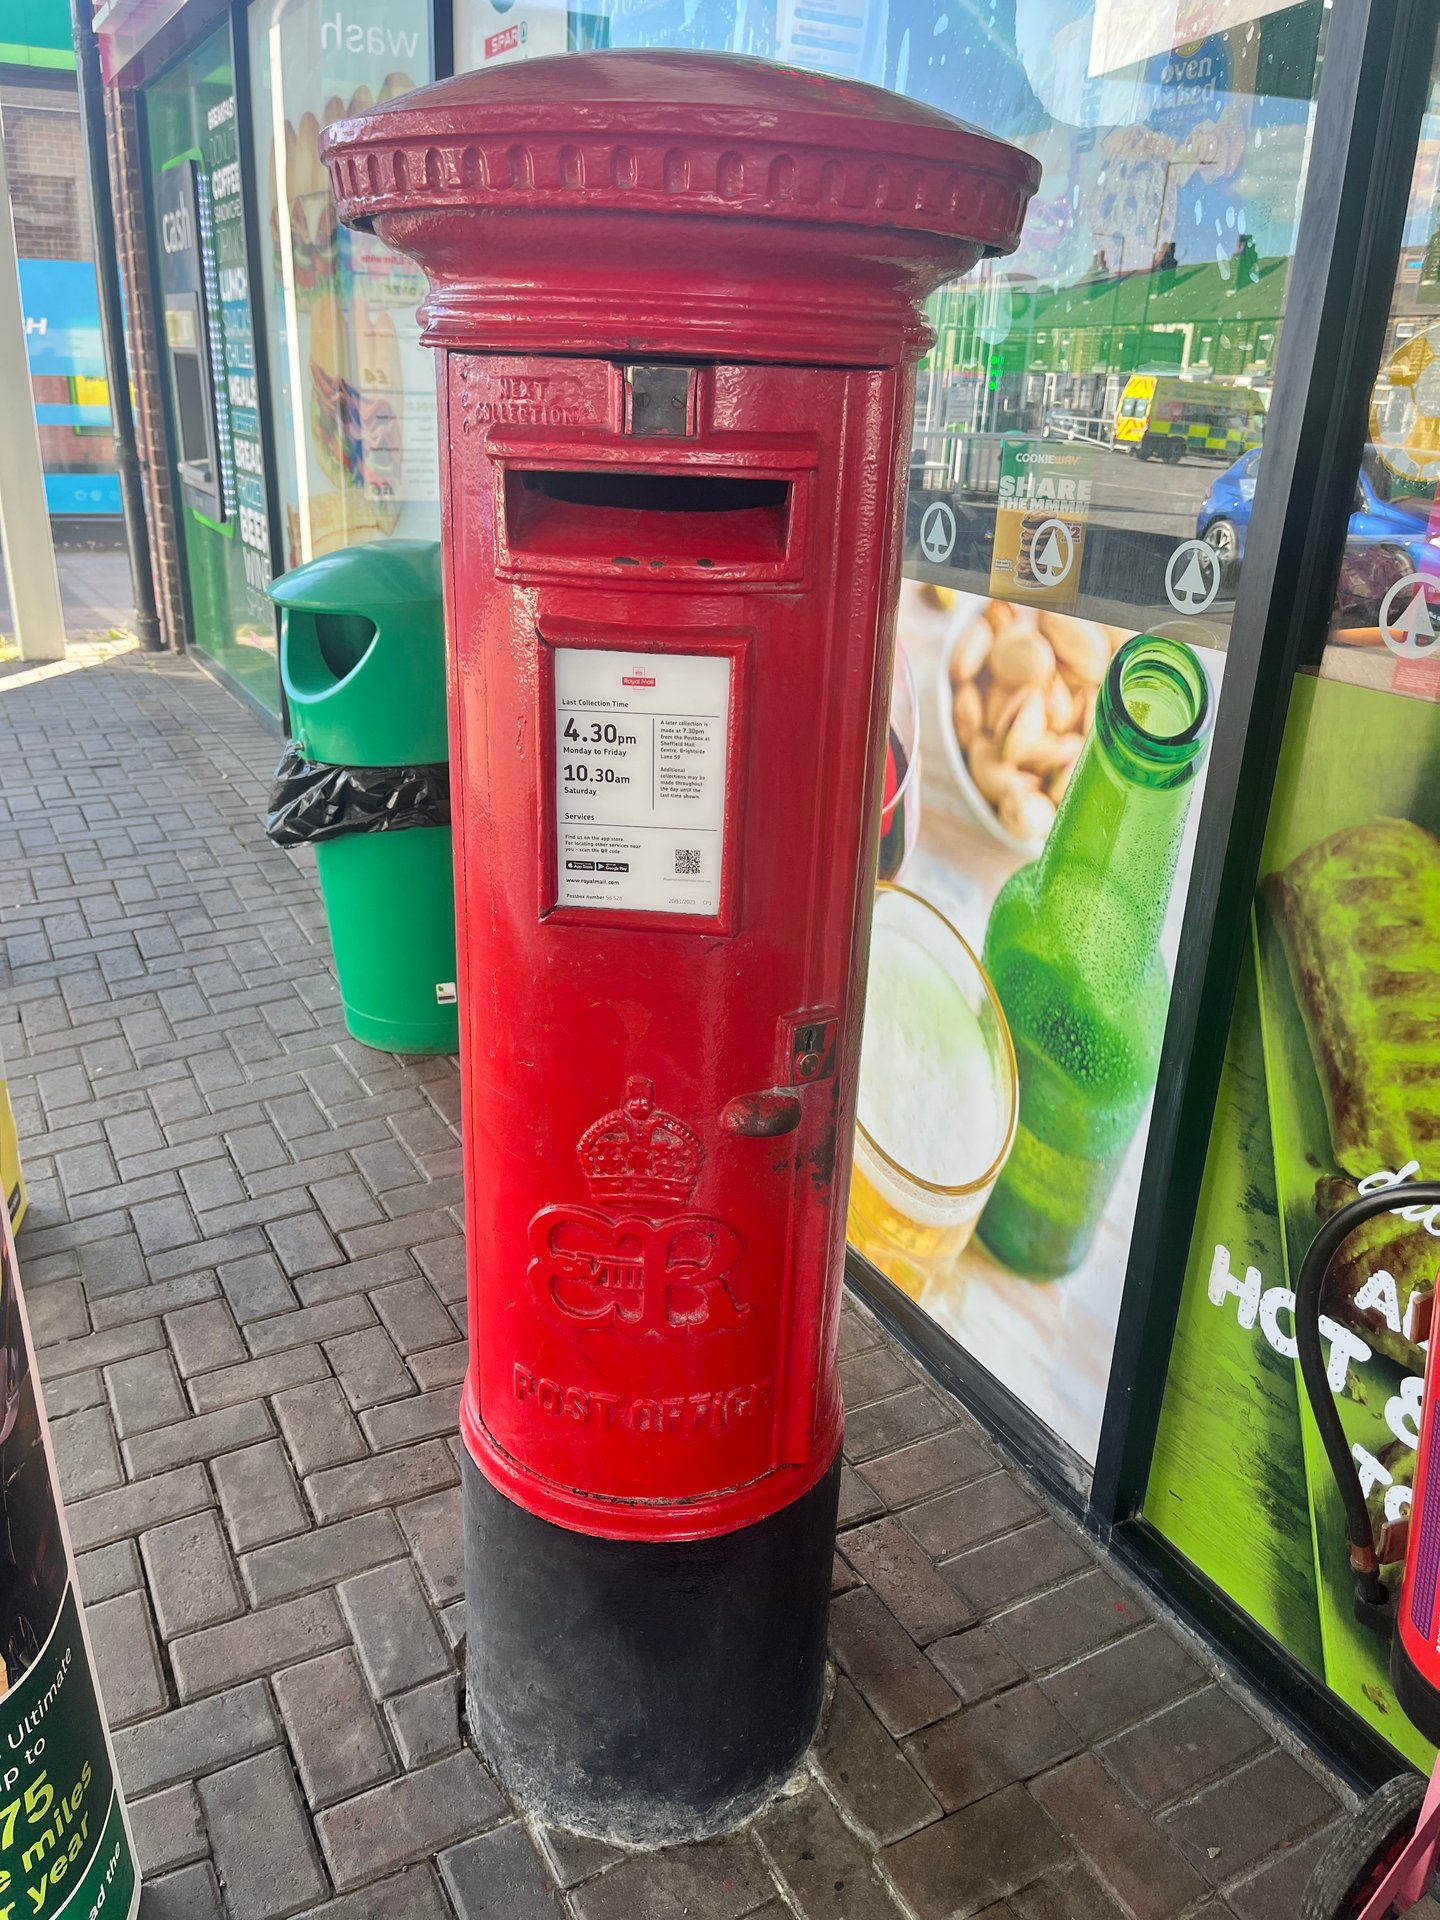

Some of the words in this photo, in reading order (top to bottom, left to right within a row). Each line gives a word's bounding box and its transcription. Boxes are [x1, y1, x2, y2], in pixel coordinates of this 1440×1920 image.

[490, 28, 519, 53] SPAR
[1161, 56, 1212, 84] oven
[162, 190, 193, 254] cash
[499, 377, 545, 400] NEXT
[1015, 452, 1080, 465] COOKIEWAY
[999, 475, 1093, 501] SHARE
[998, 496, 1028, 510] THE
[239, 504, 268, 554] BEER
[641, 678, 655, 686] Mail
[562, 698, 577, 706] Last
[578, 699, 611, 707] Collection
[563, 717, 637, 746] 4.30pm
[682, 727, 705, 735] 7.30pm
[563, 747, 593, 756] Monday
[603, 748, 627, 758] Friday
[564, 764, 631, 784] 10.30am
[564, 786, 597, 796] Saturday
[564, 812, 595, 821] Services
[1208, 1244, 1372, 1392] HOT
[514, 1362, 620, 1430] POST
[631, 1376, 772, 1432] OFFICE
[8, 1647, 72, 1749] Ultimate
[0, 1766, 20, 1792] p
[24, 1737, 46, 1765] to
[0, 1769, 55, 1850] 75
[21, 1759, 92, 1873] miles
[26, 1810, 89, 1915] year
[105, 1840, 122, 1886] the
